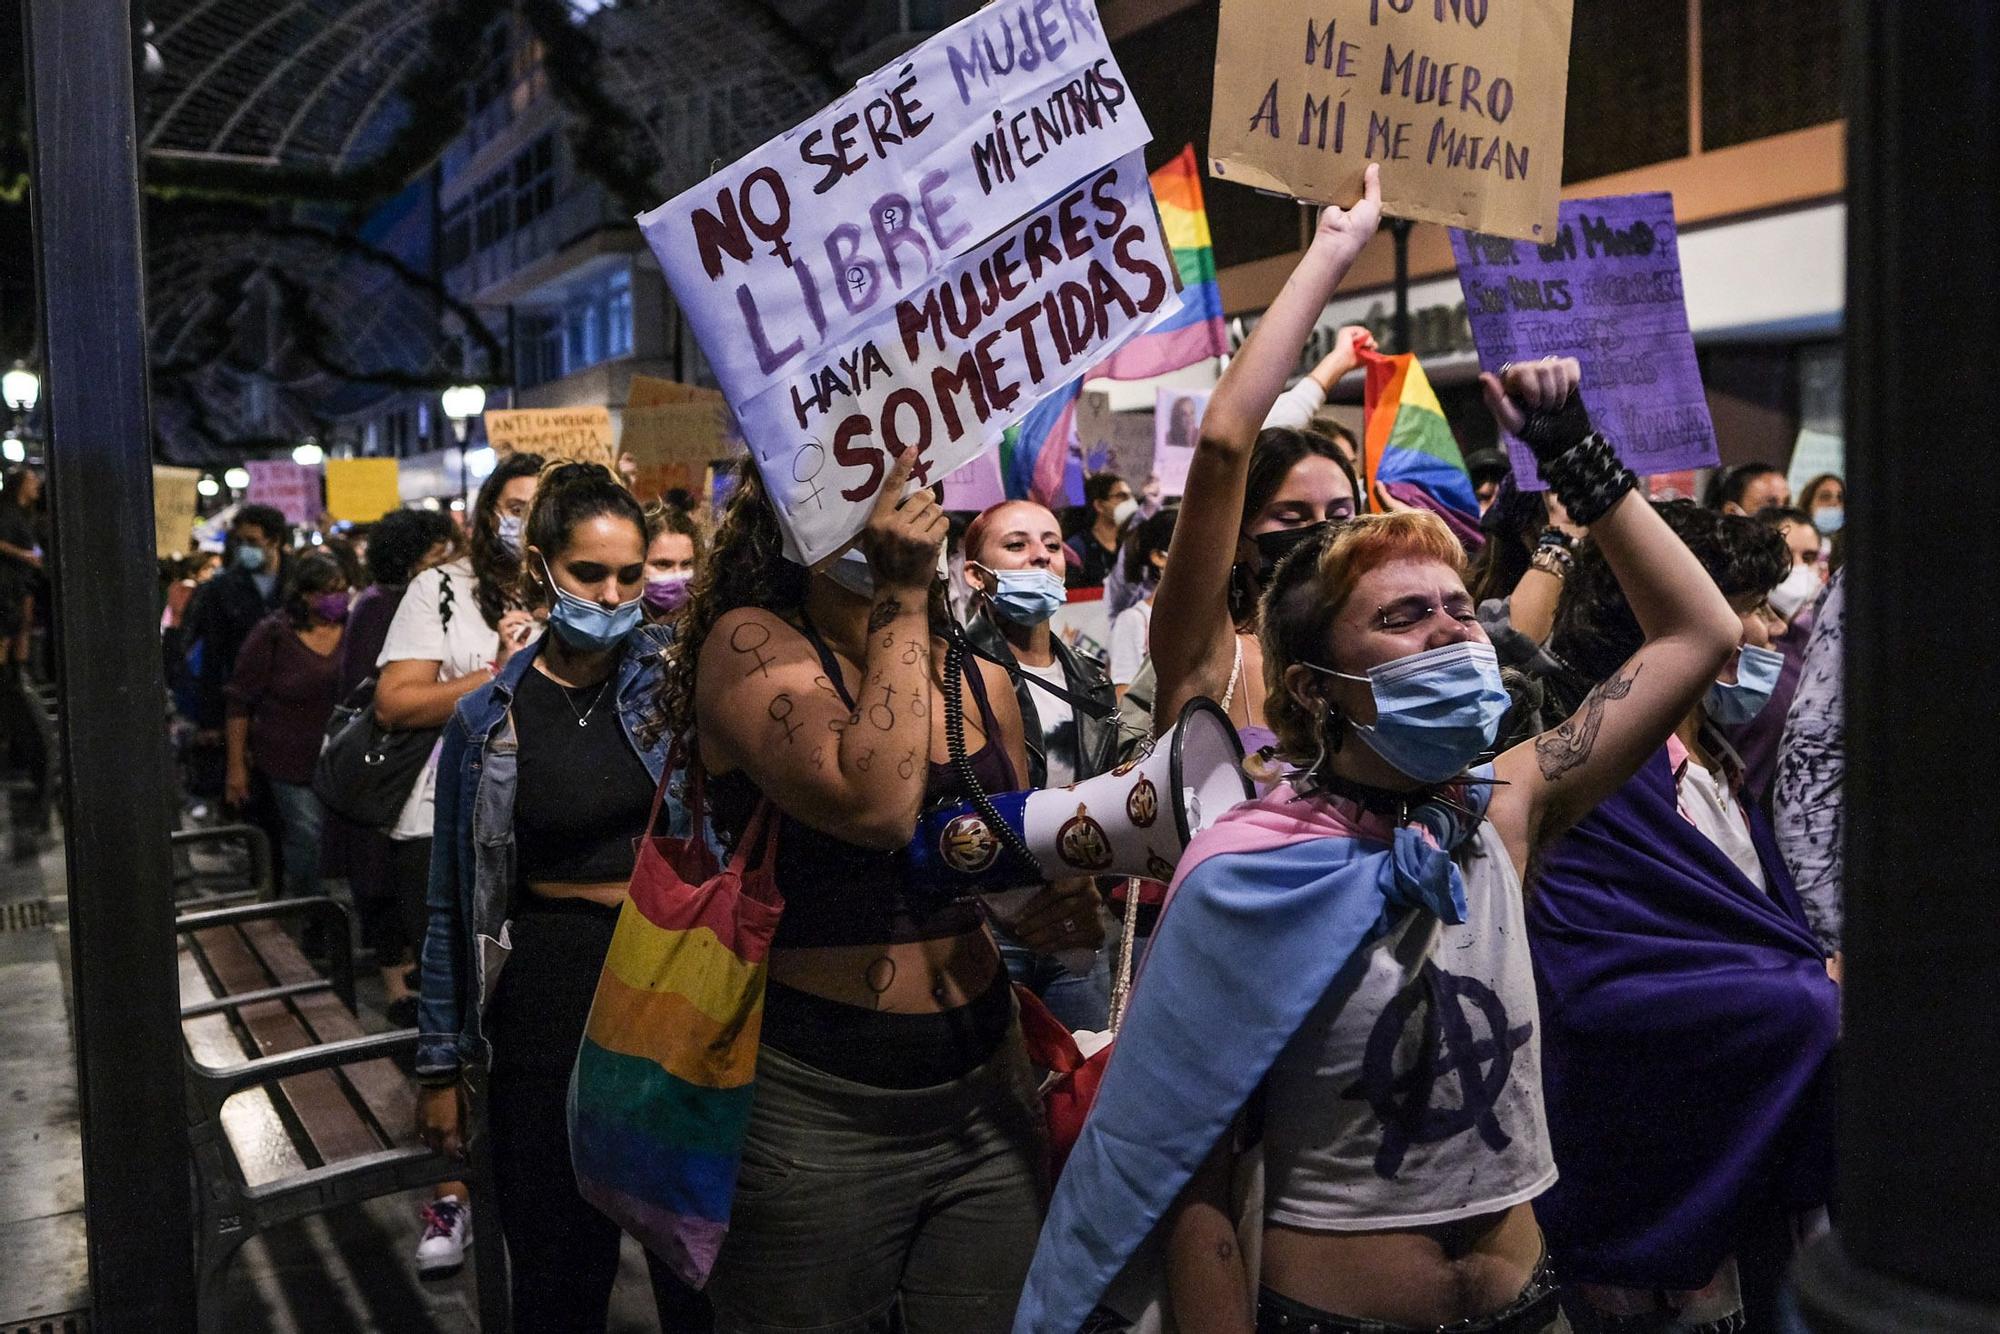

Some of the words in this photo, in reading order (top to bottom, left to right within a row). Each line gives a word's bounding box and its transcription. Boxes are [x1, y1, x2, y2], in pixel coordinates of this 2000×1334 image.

[691, 166, 793, 282] NO
[799, 62, 935, 195] SERÉ
[946, 0, 1097, 105] MUJER
[1250, 79, 1281, 138] A
[1297, 89, 1351, 154] MÍ
[1365, 110, 1413, 160] ME
[1427, 116, 1529, 181] MATAN
[1305, 18, 1361, 77] ME
[1380, 44, 1514, 124] MUERO
[736, 167, 974, 376] LIBRE
[971, 58, 1126, 196] MIENTRAS
[789, 340, 894, 431] HAYA
[895, 168, 1127, 364] MUJERES
[833, 224, 1167, 503] SOMETIDAS
